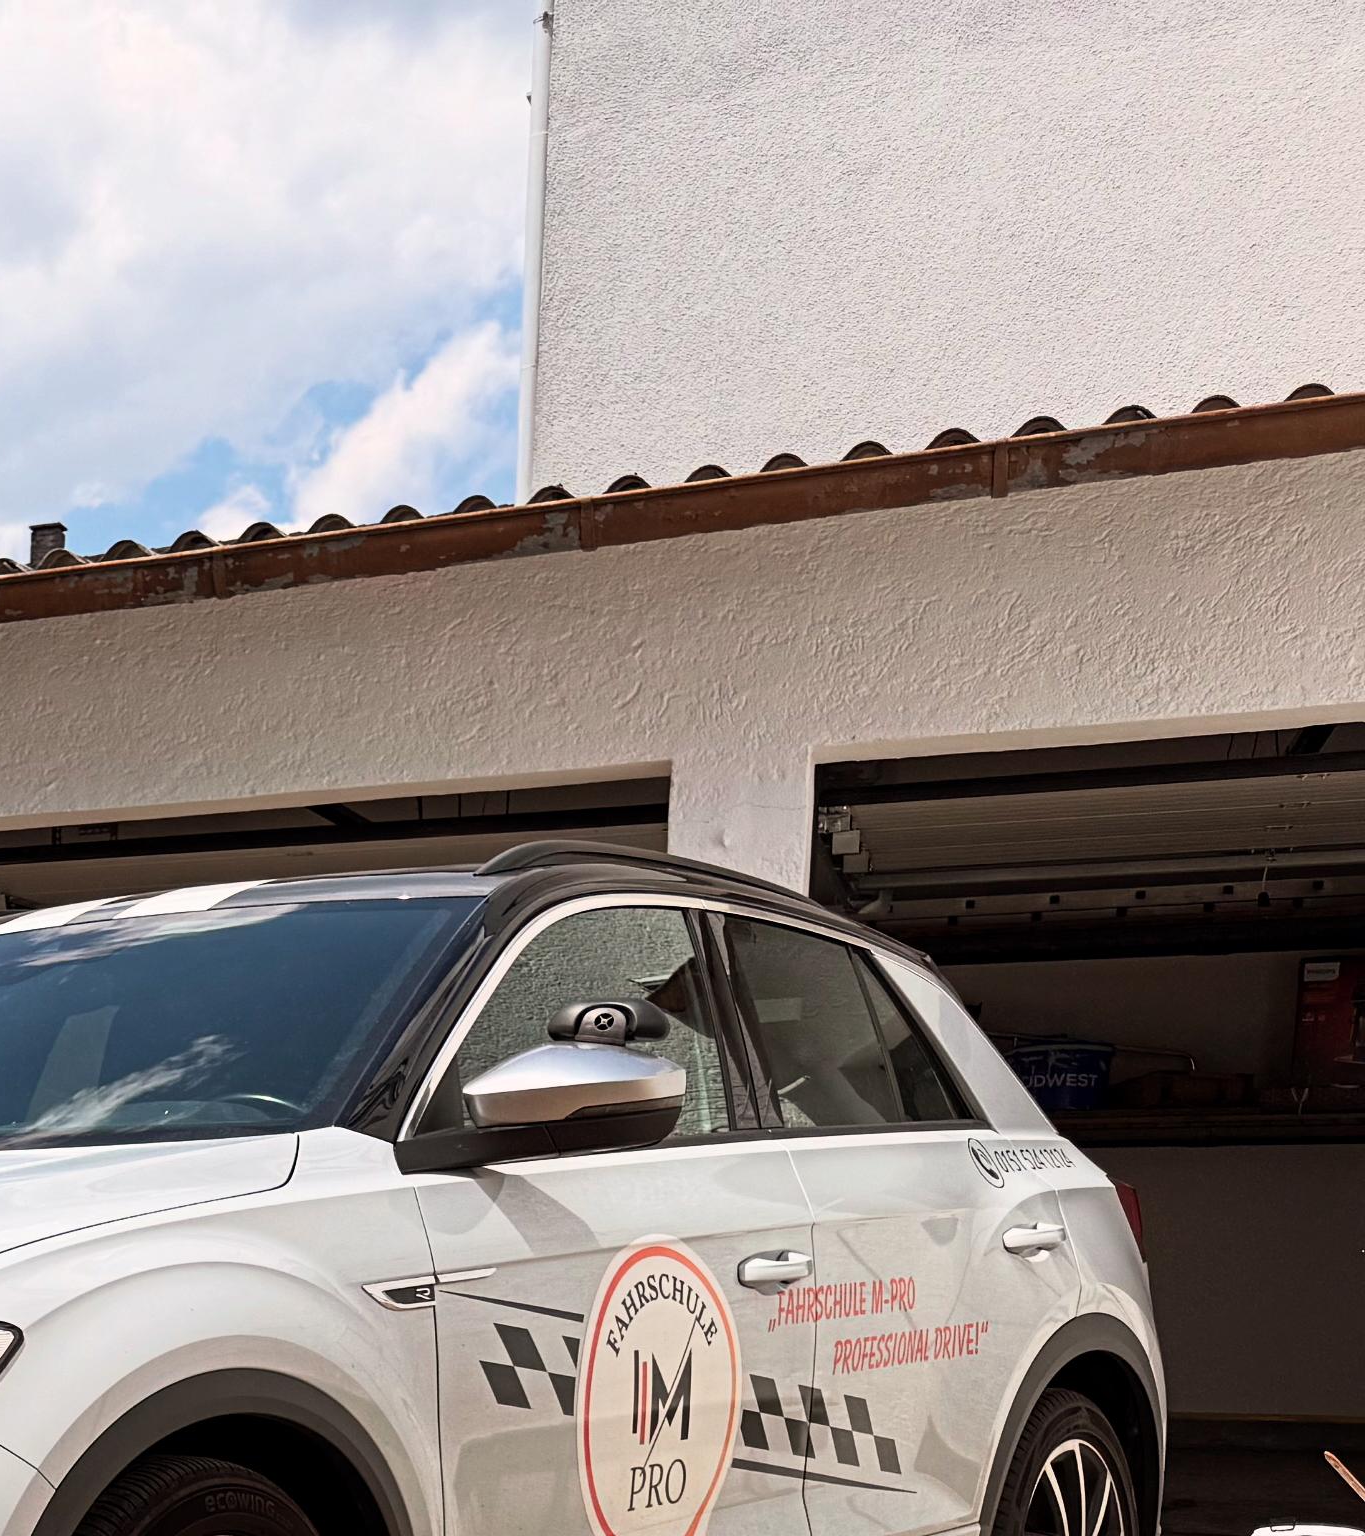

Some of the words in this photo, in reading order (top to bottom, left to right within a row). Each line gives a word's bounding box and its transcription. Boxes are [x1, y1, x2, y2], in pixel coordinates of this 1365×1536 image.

[1026, 1072, 1099, 1088] DWEST
[994, 1150, 1027, 1173] 0151
[605, 1273, 718, 1357] FAHRSCHULE
[871, 1276, 916, 1315] M-PRO
[832, 1328, 929, 1375] PROFESSIONAL
[627, 1458, 687, 1512] PRO
